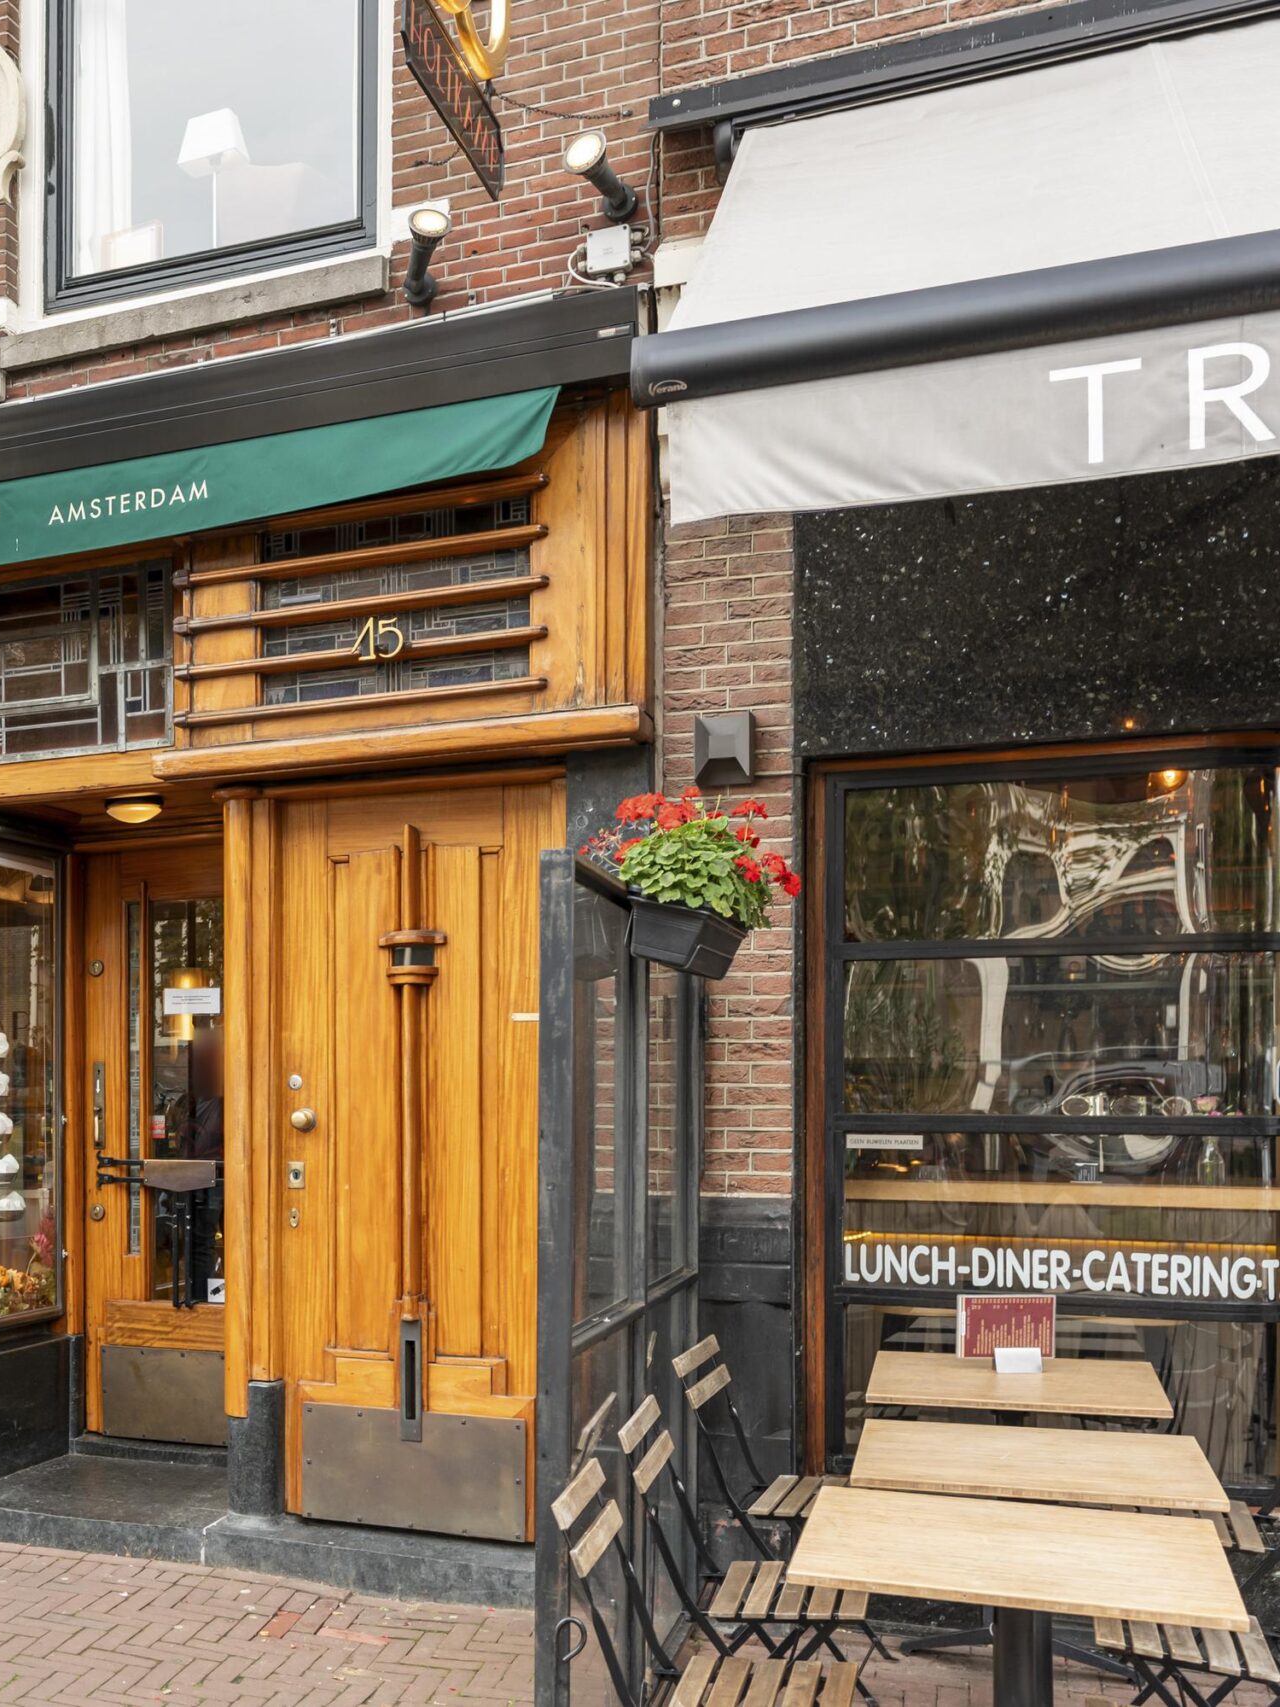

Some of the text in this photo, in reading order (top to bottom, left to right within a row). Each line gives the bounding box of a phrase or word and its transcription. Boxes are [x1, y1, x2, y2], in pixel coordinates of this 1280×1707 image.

[409, 0, 499, 173] HOLTKAMP
[48, 479, 209, 525] AMSTERDAM
[351, 617, 413, 661] 15
